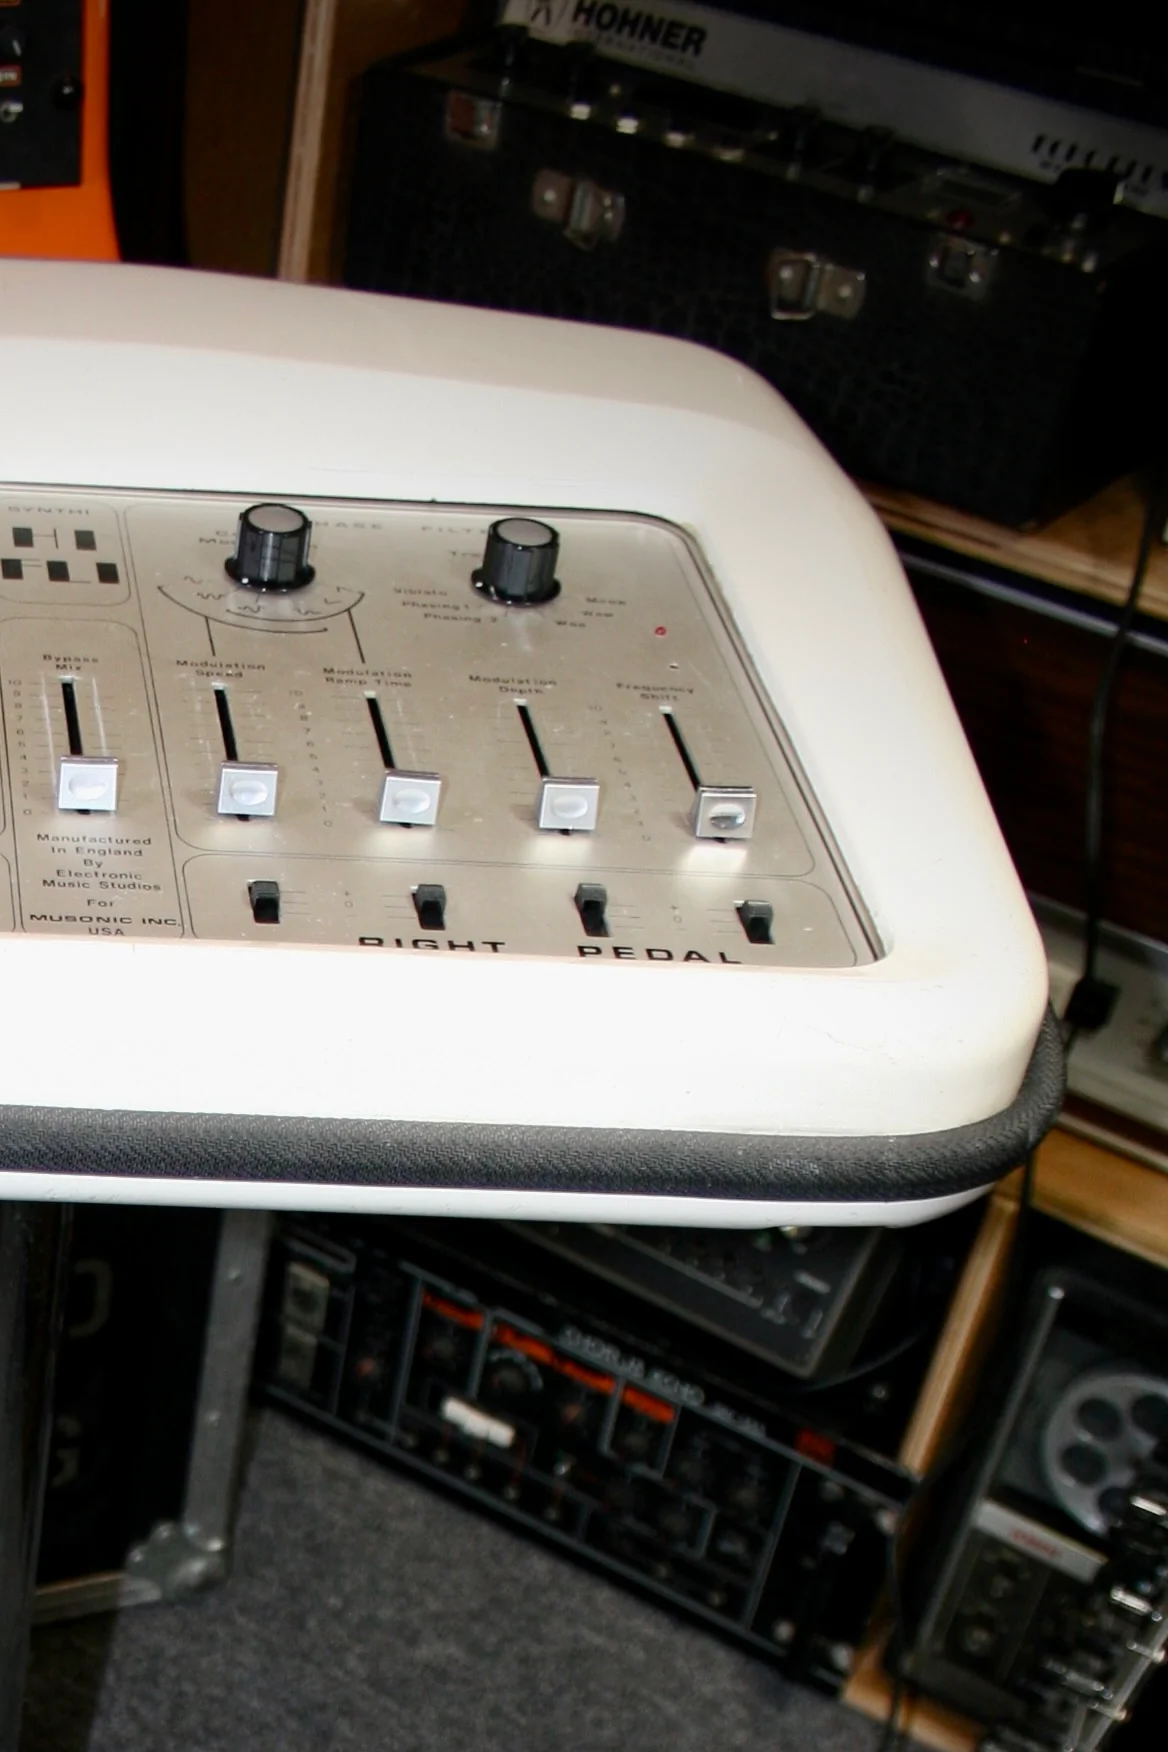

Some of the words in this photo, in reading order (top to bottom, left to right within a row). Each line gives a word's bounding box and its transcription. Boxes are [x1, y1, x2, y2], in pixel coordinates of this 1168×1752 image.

[573, 1, 707, 57] HOHNER
[8, 505, 90, 516] SYNTHI
[402, 600, 460, 611] Phasing
[423, 612, 482, 624] Phasing
[42, 653, 99, 664] Bypass
[55, 663, 82, 671] Mix
[175, 659, 266, 672] Modulation
[195, 669, 244, 679] Speed
[322, 667, 413, 679] Modulation
[324, 676, 368, 687] Ramp
[374, 678, 413, 688] Time
[468, 674, 558, 687] Modulation
[498, 685, 544, 696] Depth
[616, 682, 694, 695] Frequency
[37, 833, 152, 845] Manufactured
[51, 846, 67, 854] In
[75, 846, 143, 857] England
[83, 858, 103, 869] By
[56, 869, 143, 881] Electronic
[42, 879, 90, 889] Music
[99, 880, 161, 891] Studios
[86, 898, 115, 908] For
[29, 913, 133, 925] MUSONIC
[141, 917, 182, 927] INC.
[88, 927, 125, 937] USA
[577, 945, 743, 964] PEDAL
